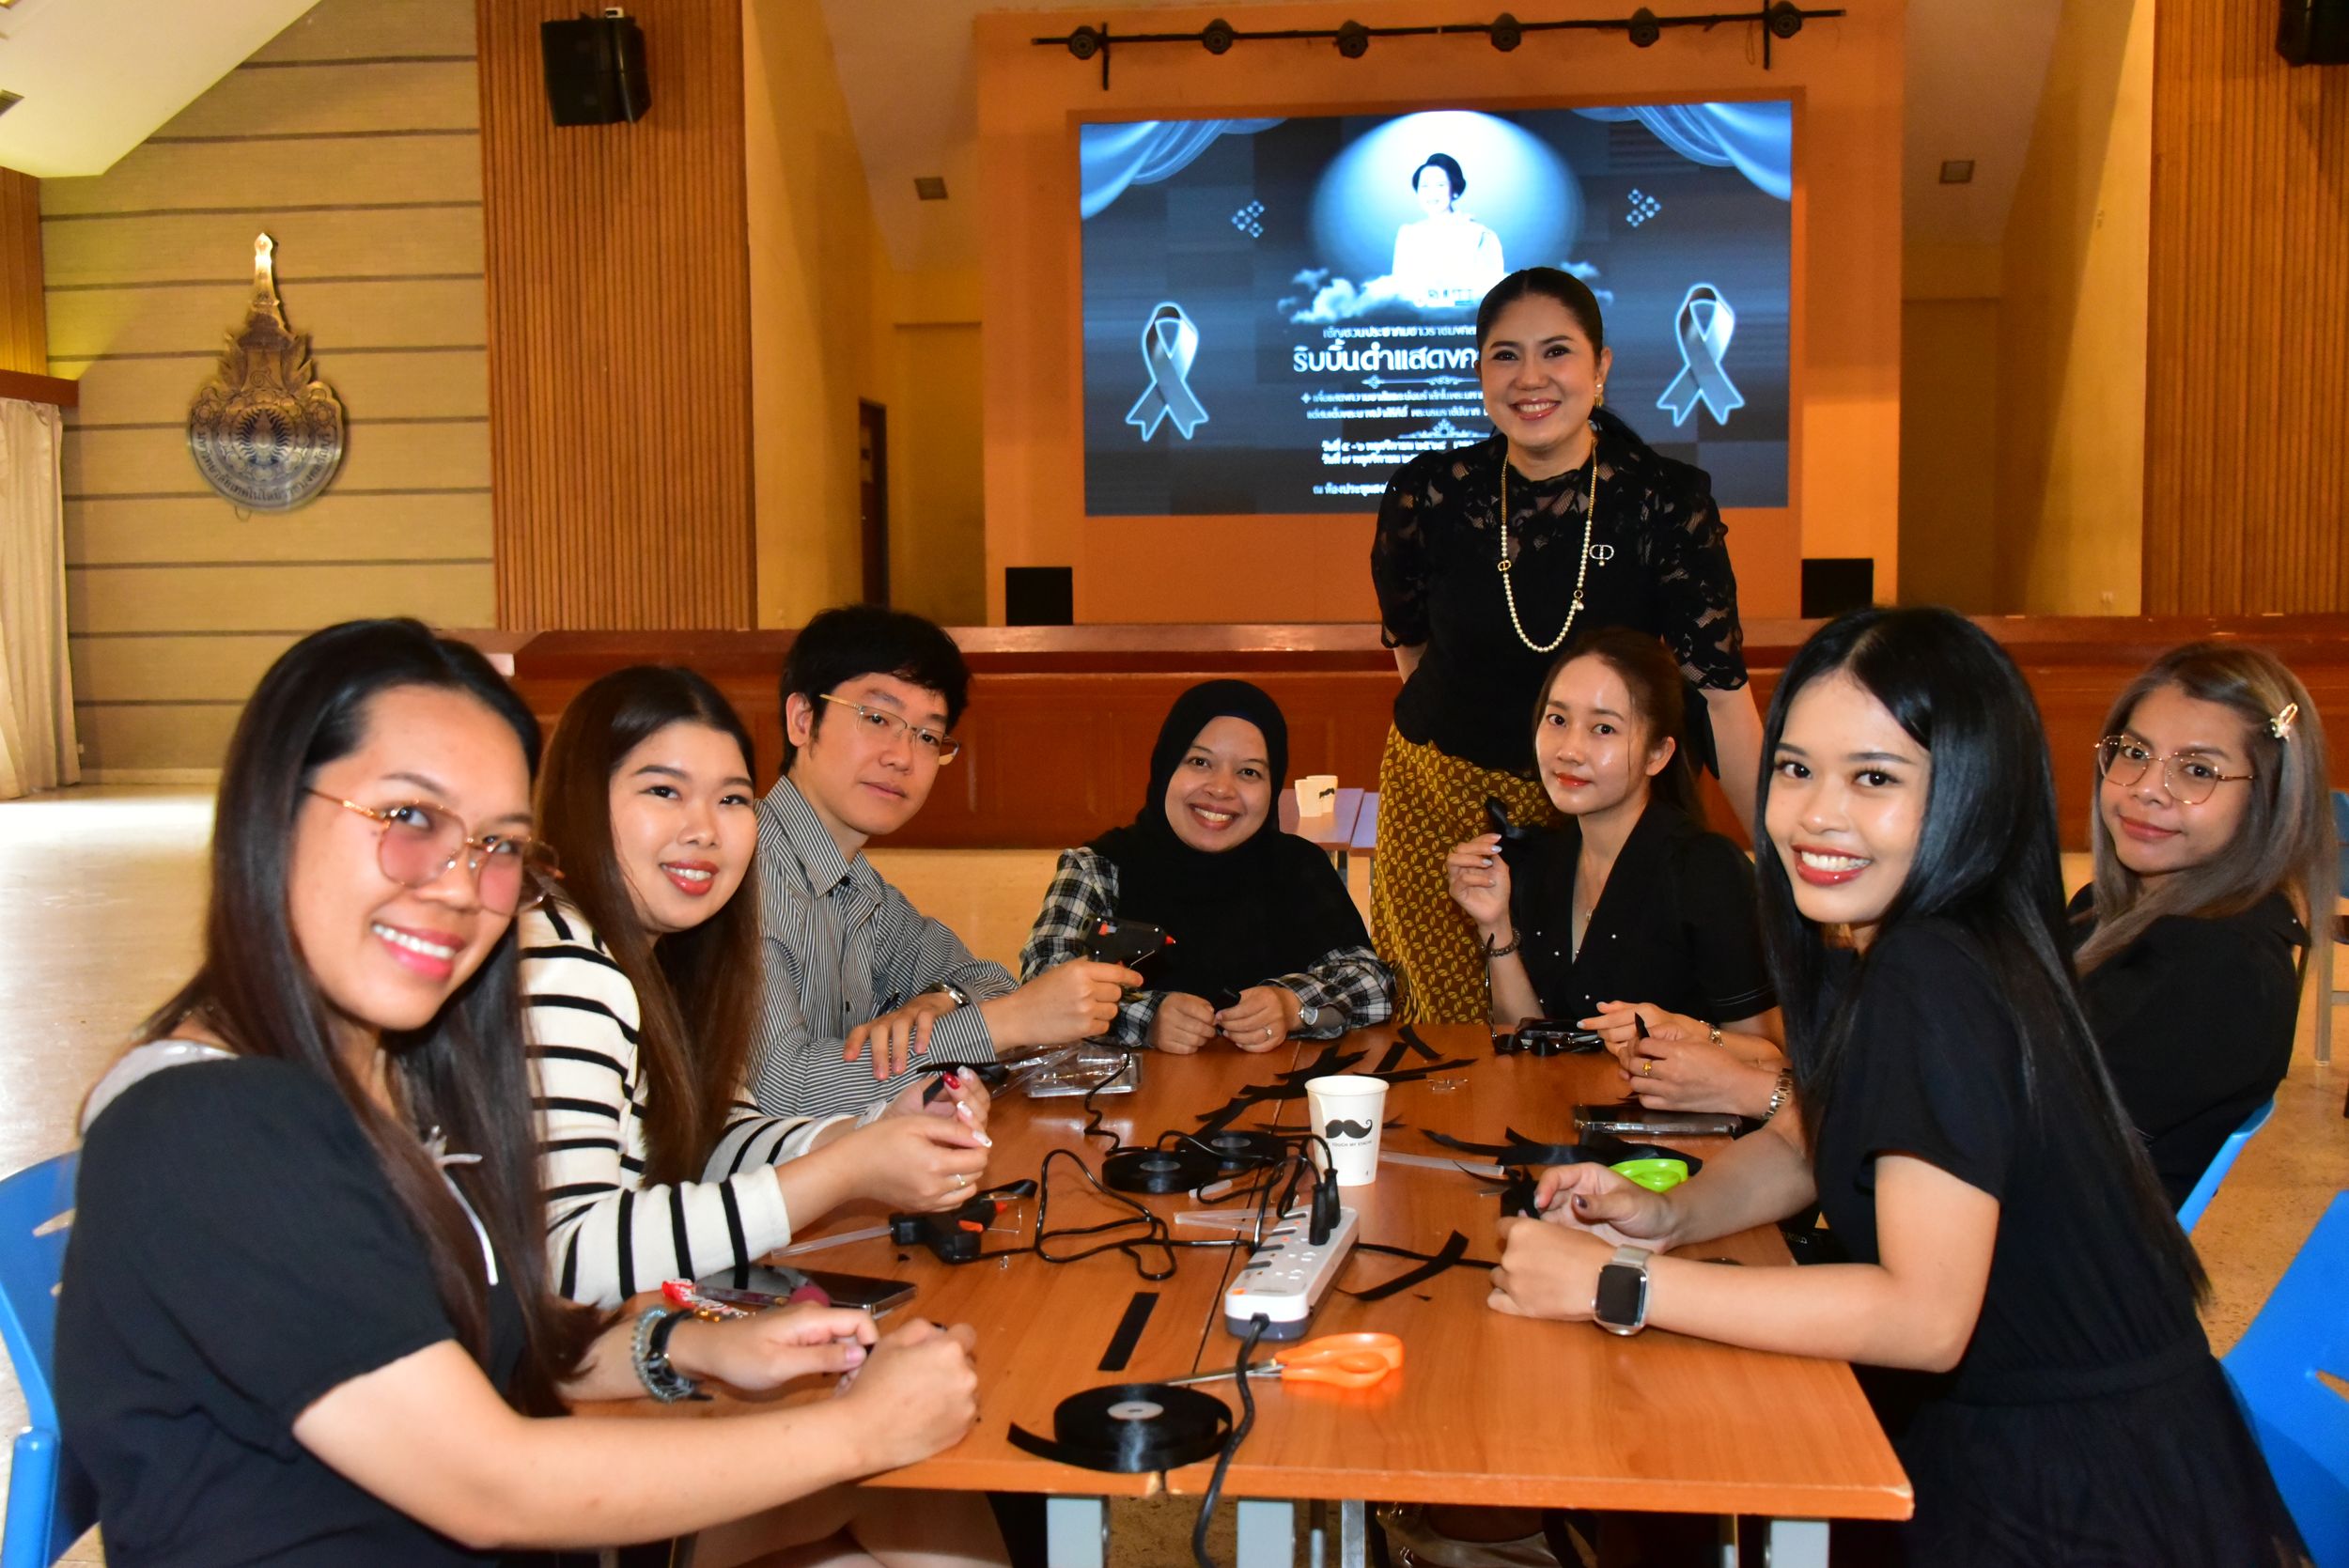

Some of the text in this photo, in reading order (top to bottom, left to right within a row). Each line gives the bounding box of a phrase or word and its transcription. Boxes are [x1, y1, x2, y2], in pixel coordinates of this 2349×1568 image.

[1293, 338, 1479, 372] ริบบิ้นดำแสดงค
